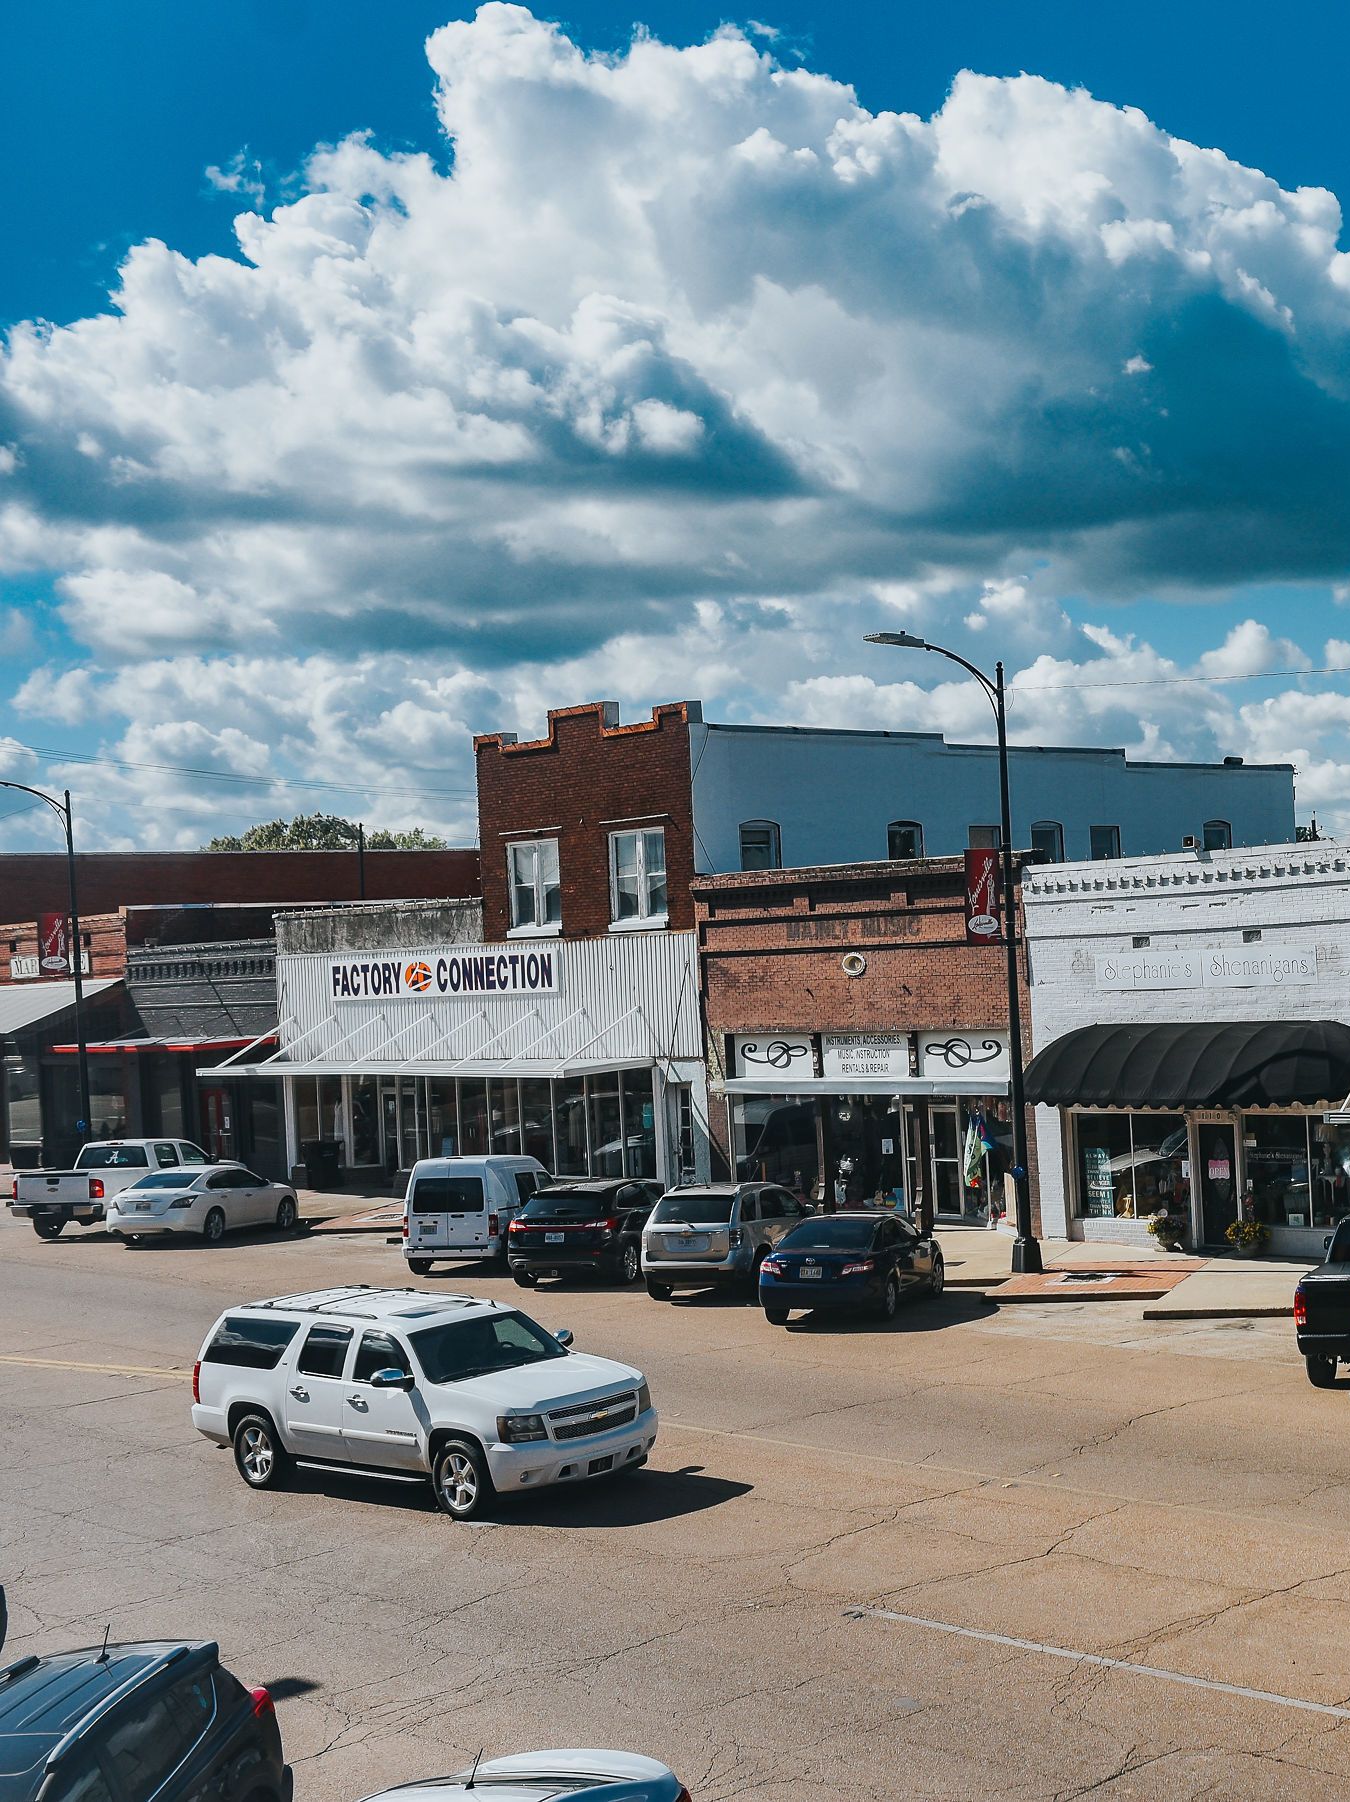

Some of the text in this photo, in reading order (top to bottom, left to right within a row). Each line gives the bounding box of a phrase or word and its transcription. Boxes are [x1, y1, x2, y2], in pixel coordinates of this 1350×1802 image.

[332, 953, 553, 997] FACTORY CONNECTION
[1104, 956, 1192, 987] Stephanie's
[1210, 954, 1309, 983] Shenanigans
[842, 1063, 865, 1074] RENTALS
[870, 1062, 890, 1073] REPAIR
